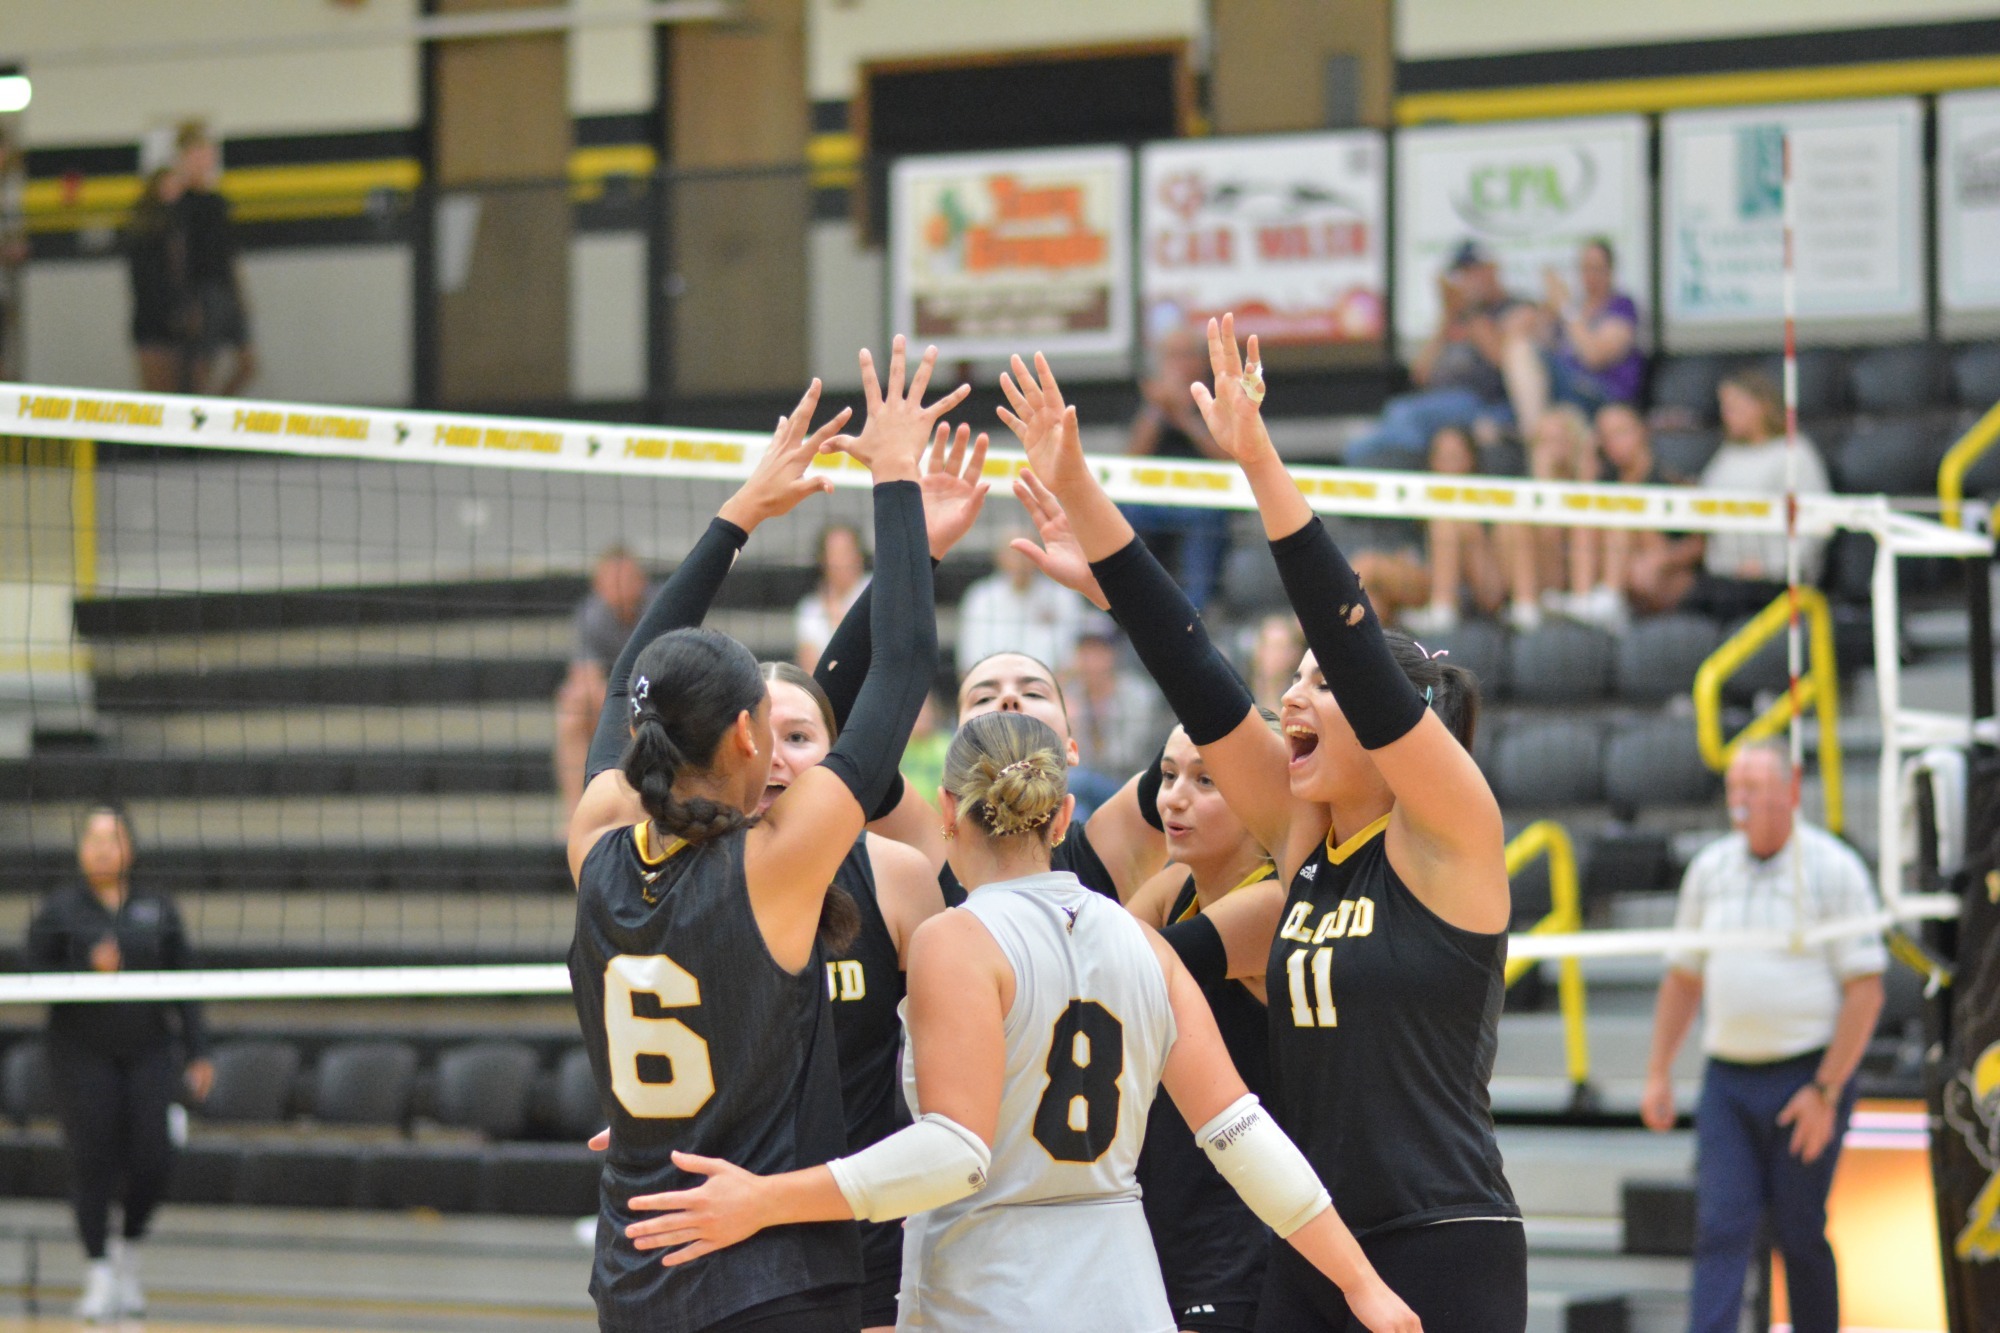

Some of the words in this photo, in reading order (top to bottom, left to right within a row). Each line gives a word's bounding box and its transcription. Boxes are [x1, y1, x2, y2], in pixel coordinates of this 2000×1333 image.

[1469, 163, 1566, 211] CPA
[1157, 229, 1232, 267] CAR
[1258, 221, 1366, 261] WASH
[1286, 946, 1338, 1027] 11
[603, 953, 716, 1119] 6
[1032, 997, 1124, 1165] 8
[1209, 1112, 1260, 1147] Tandem
